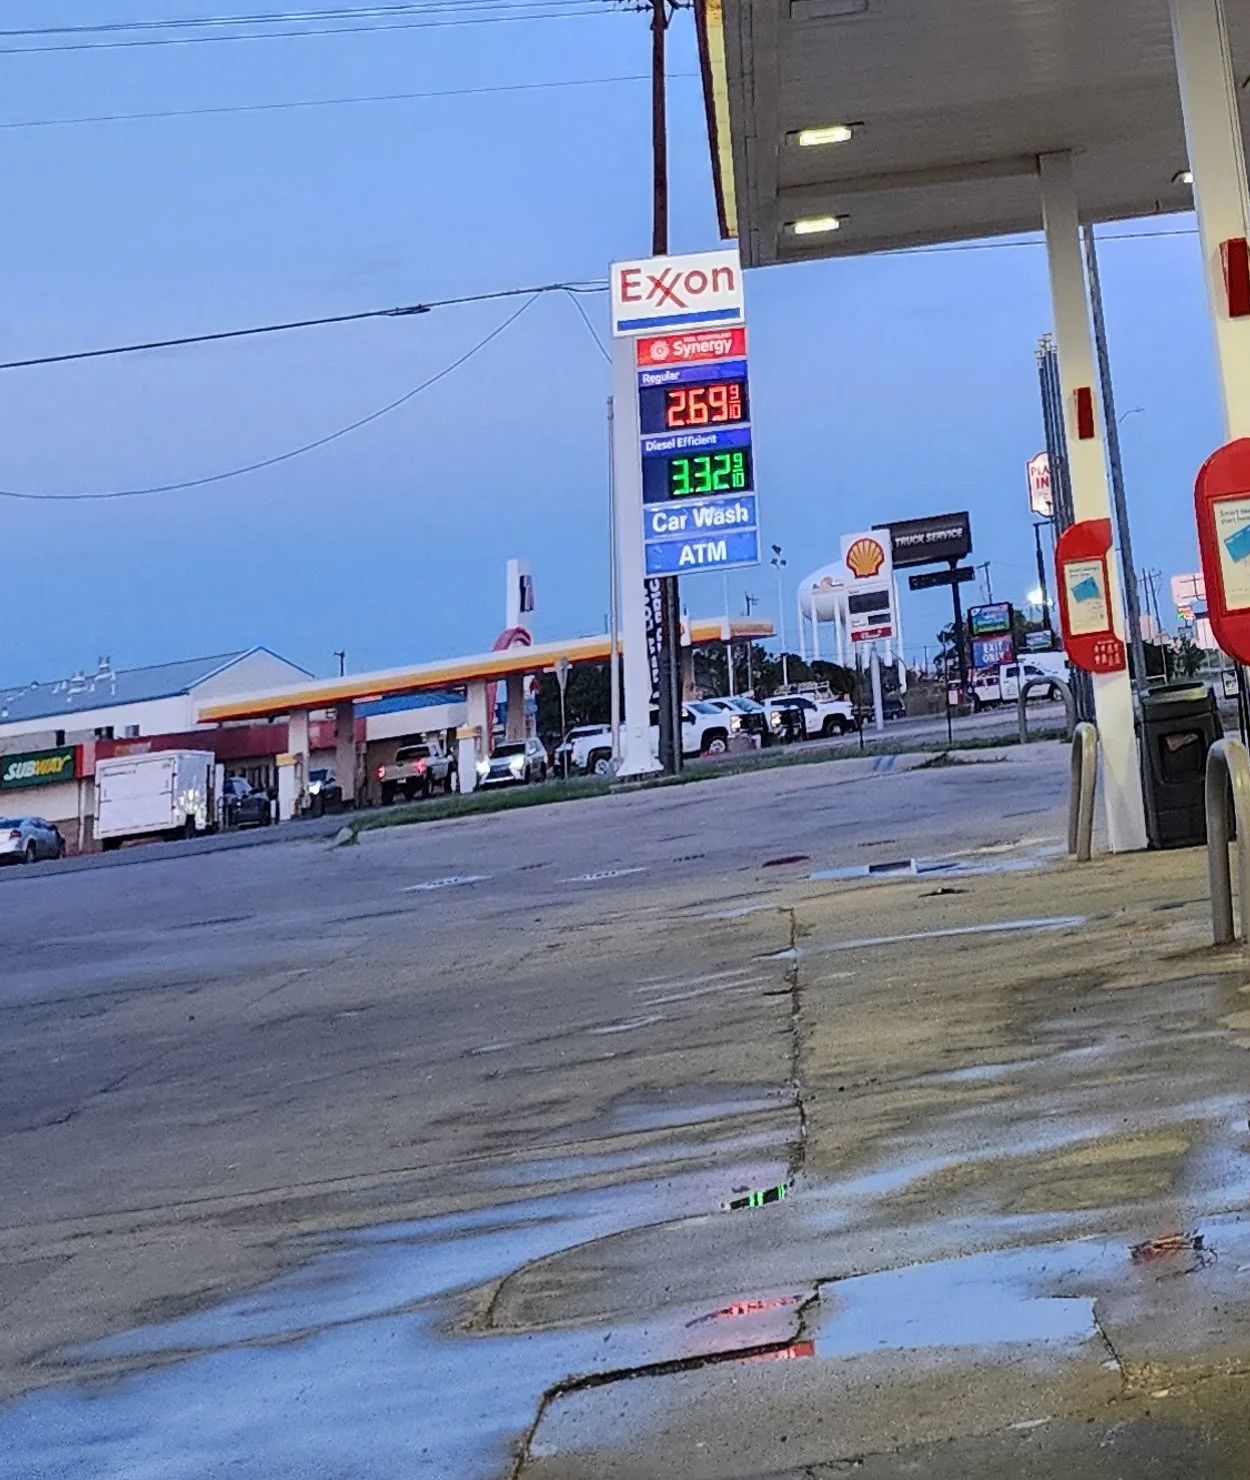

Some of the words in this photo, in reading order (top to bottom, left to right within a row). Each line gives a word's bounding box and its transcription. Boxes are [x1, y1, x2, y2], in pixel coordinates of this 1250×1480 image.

[620, 267, 735, 308] Exxon
[673, 339, 732, 358] Synergy
[642, 371, 681, 385] Regular
[645, 438, 676, 452] Diesel
[676, 434, 718, 448] Efficient
[1031, 465, 1051, 476] PLA
[652, 512, 687, 533] Car
[692, 503, 749, 528] Wash
[894, 534, 925, 548] TRUCK
[925, 528, 963, 543] SERVICE
[678, 540, 728, 566] ATM
[983, 641, 1003, 654] EXIT
[4, 755, 71, 782] SUBWAY
